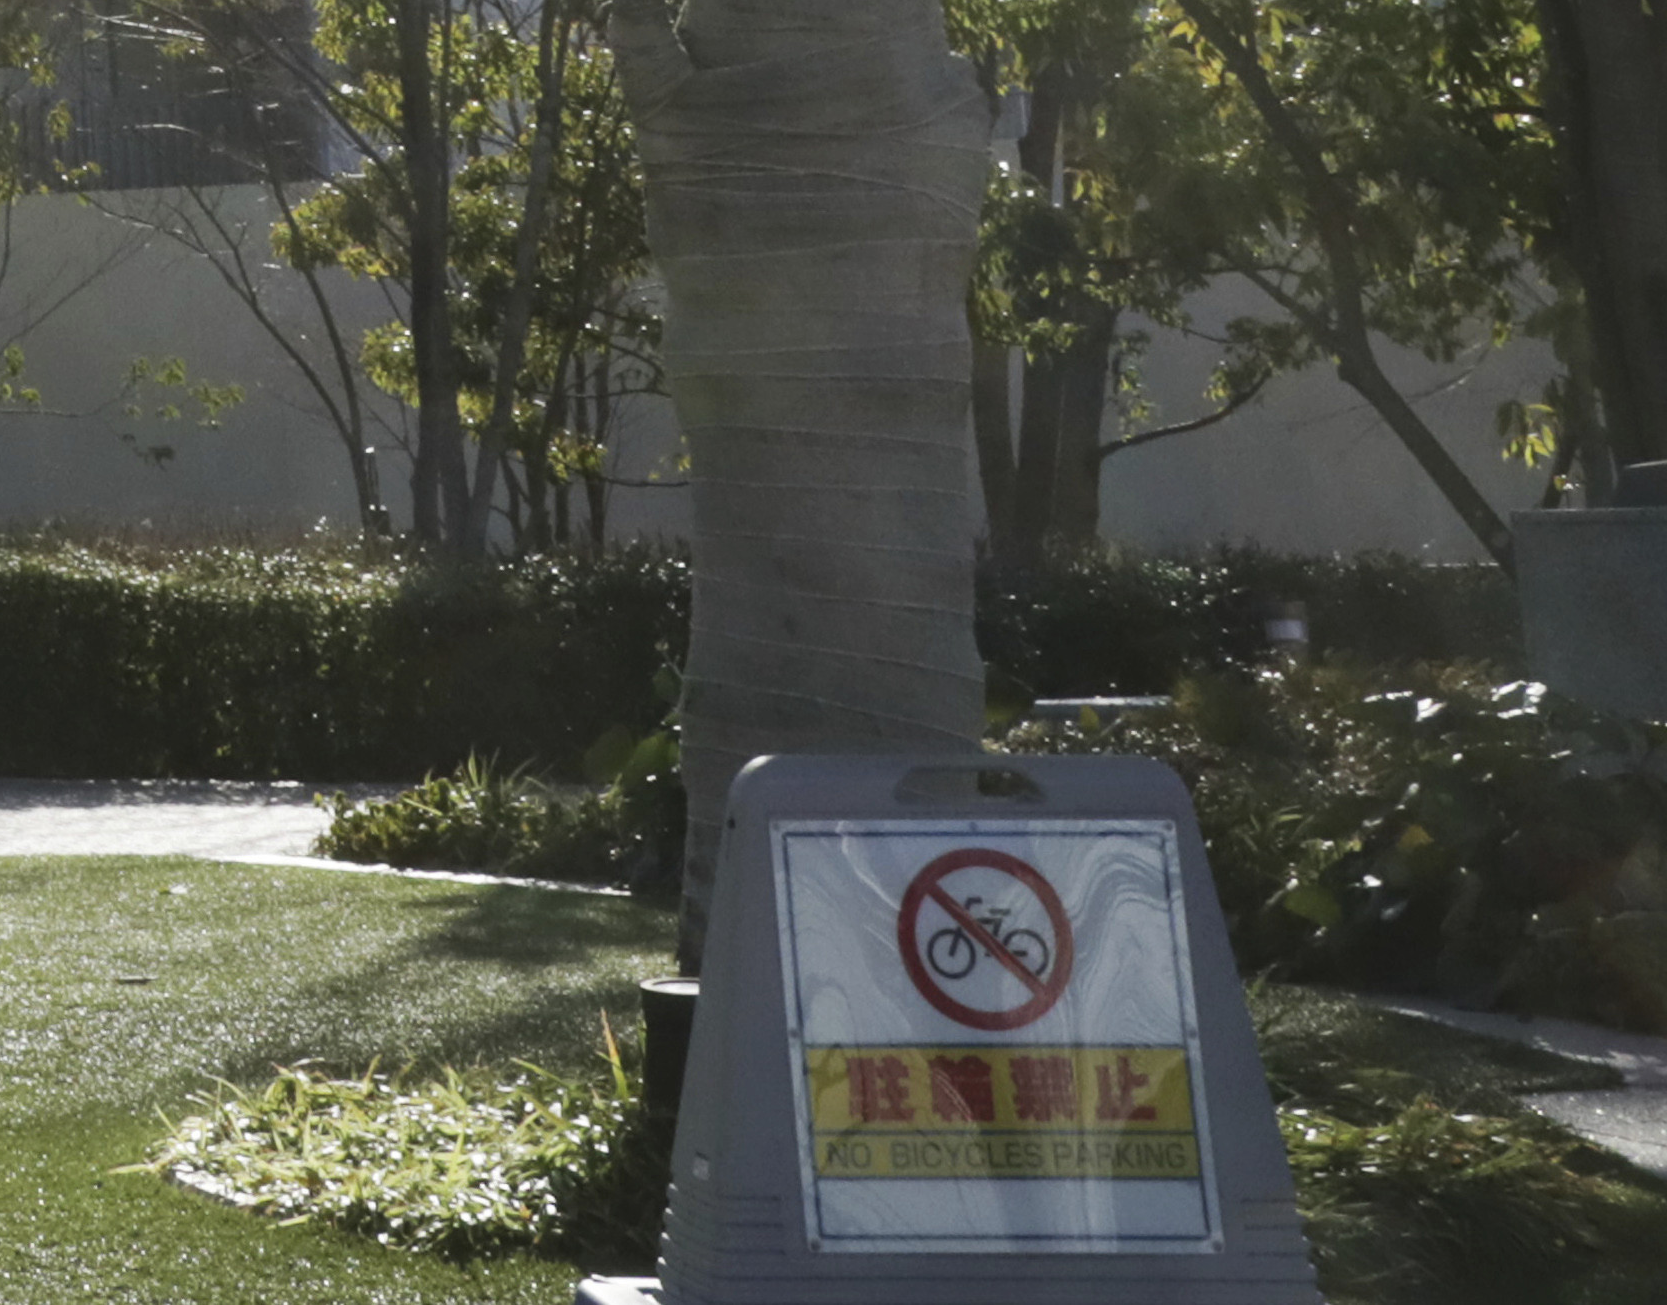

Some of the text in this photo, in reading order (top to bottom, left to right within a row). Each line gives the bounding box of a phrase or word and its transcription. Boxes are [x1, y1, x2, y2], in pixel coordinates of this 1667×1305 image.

[845, 1054, 1158, 1123] 駐輪禁止
[826, 1139, 1187, 1171] NO BICYCLES PARKING
